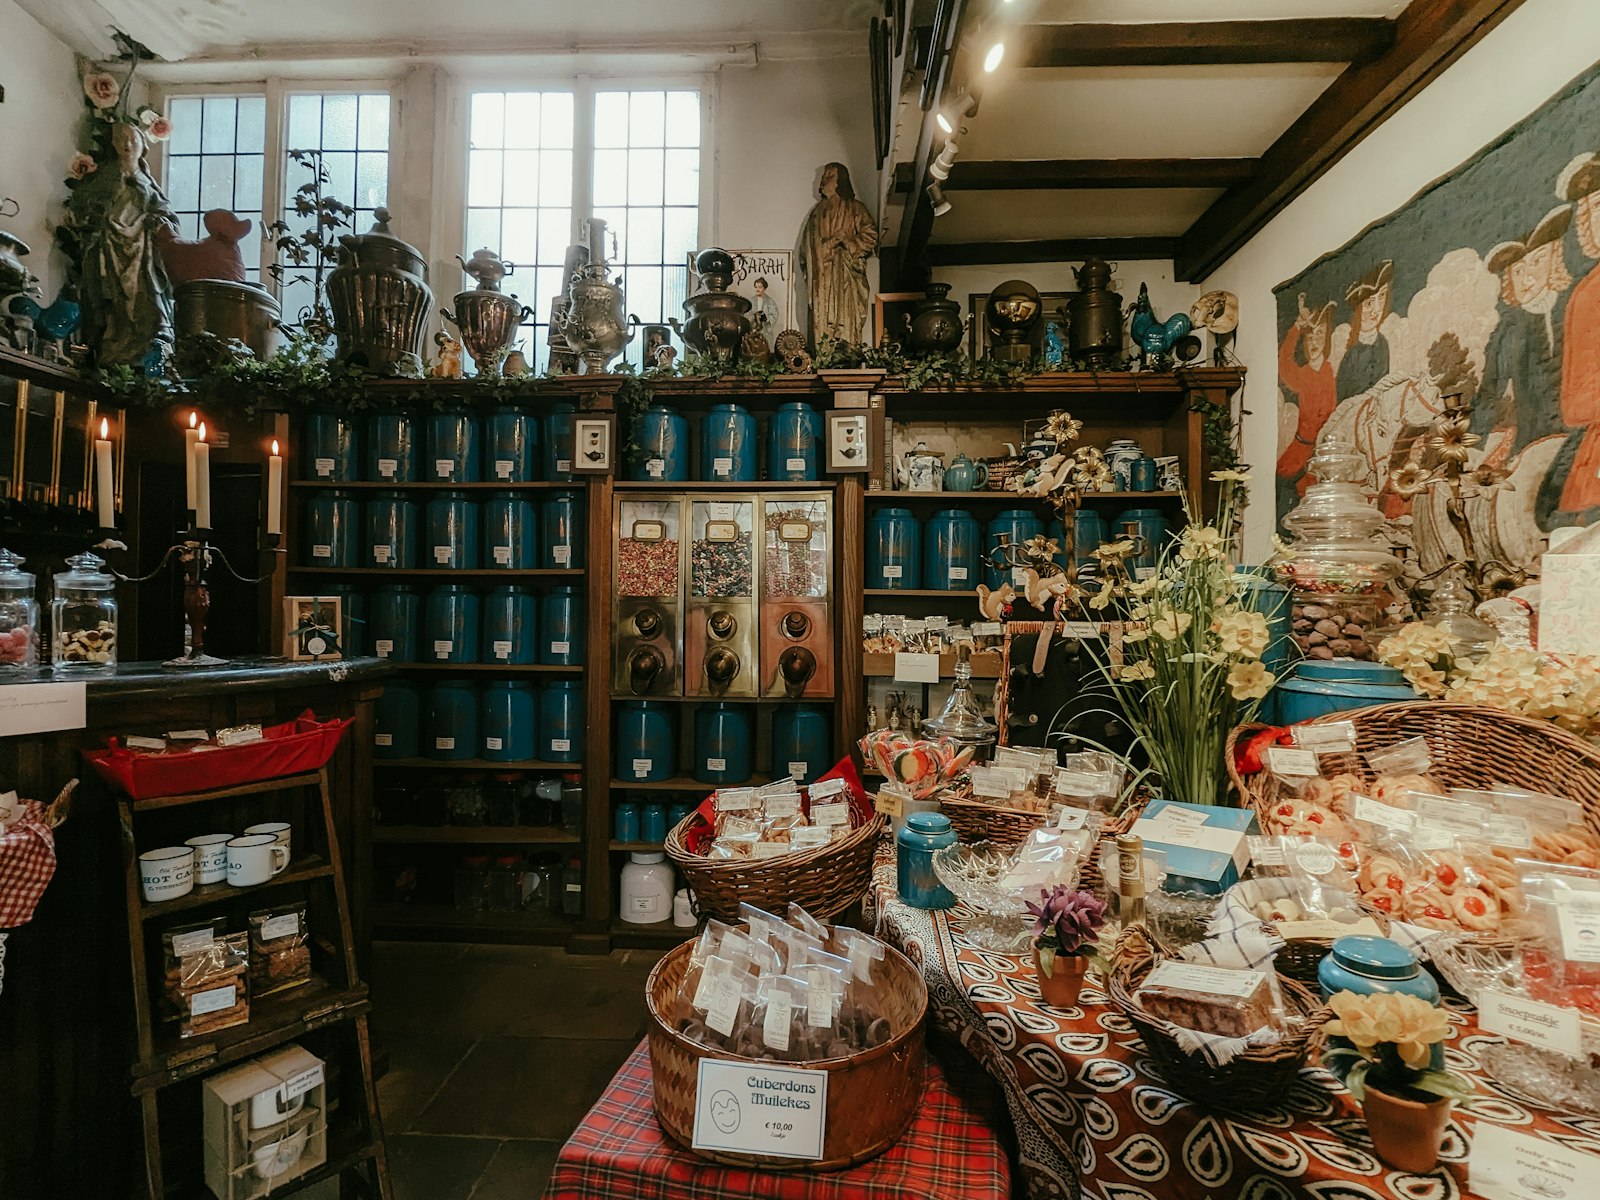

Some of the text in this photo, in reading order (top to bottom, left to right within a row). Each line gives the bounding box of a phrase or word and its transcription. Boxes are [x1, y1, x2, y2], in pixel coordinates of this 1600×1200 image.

[735, 255, 785, 286] SARAH
[143, 875, 171, 884] HOT
[747, 1076, 817, 1094] Cuberdons
[751, 1092, 811, 1110] Muilekes
[772, 1122, 793, 1131] 10,00
